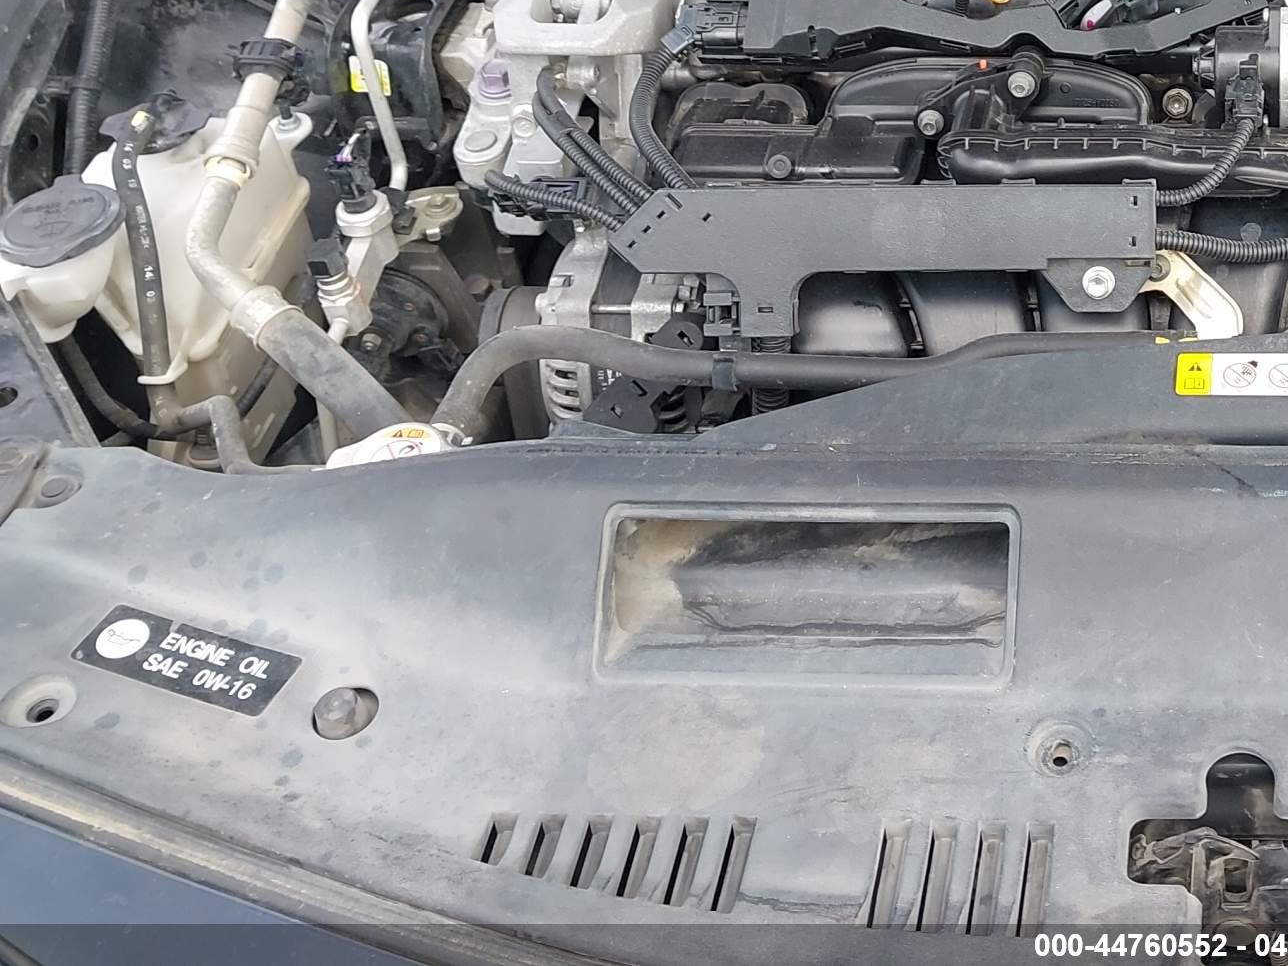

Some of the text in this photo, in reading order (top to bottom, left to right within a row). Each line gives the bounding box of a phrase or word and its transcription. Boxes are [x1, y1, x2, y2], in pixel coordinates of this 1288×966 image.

[142, 653, 257, 700] SAE 0W-16
[159, 631, 271, 680] ENGINE OIL
